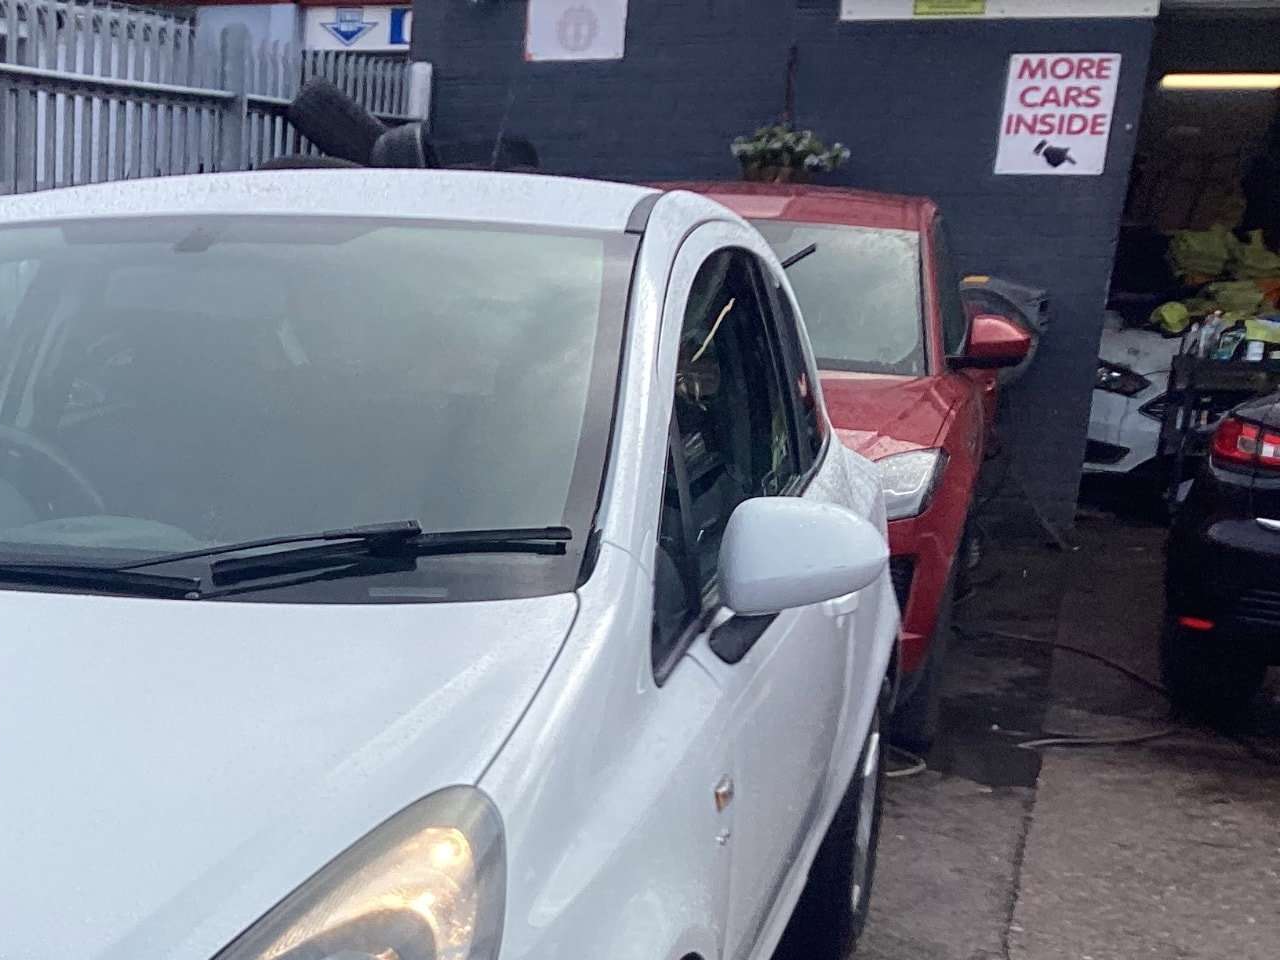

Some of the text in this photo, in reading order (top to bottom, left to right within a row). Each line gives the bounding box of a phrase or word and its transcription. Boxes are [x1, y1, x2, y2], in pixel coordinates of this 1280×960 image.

[1017, 57, 1113, 80] MORE
[1019, 86, 1101, 108] CARS
[1005, 113, 1107, 136] INSIDE
